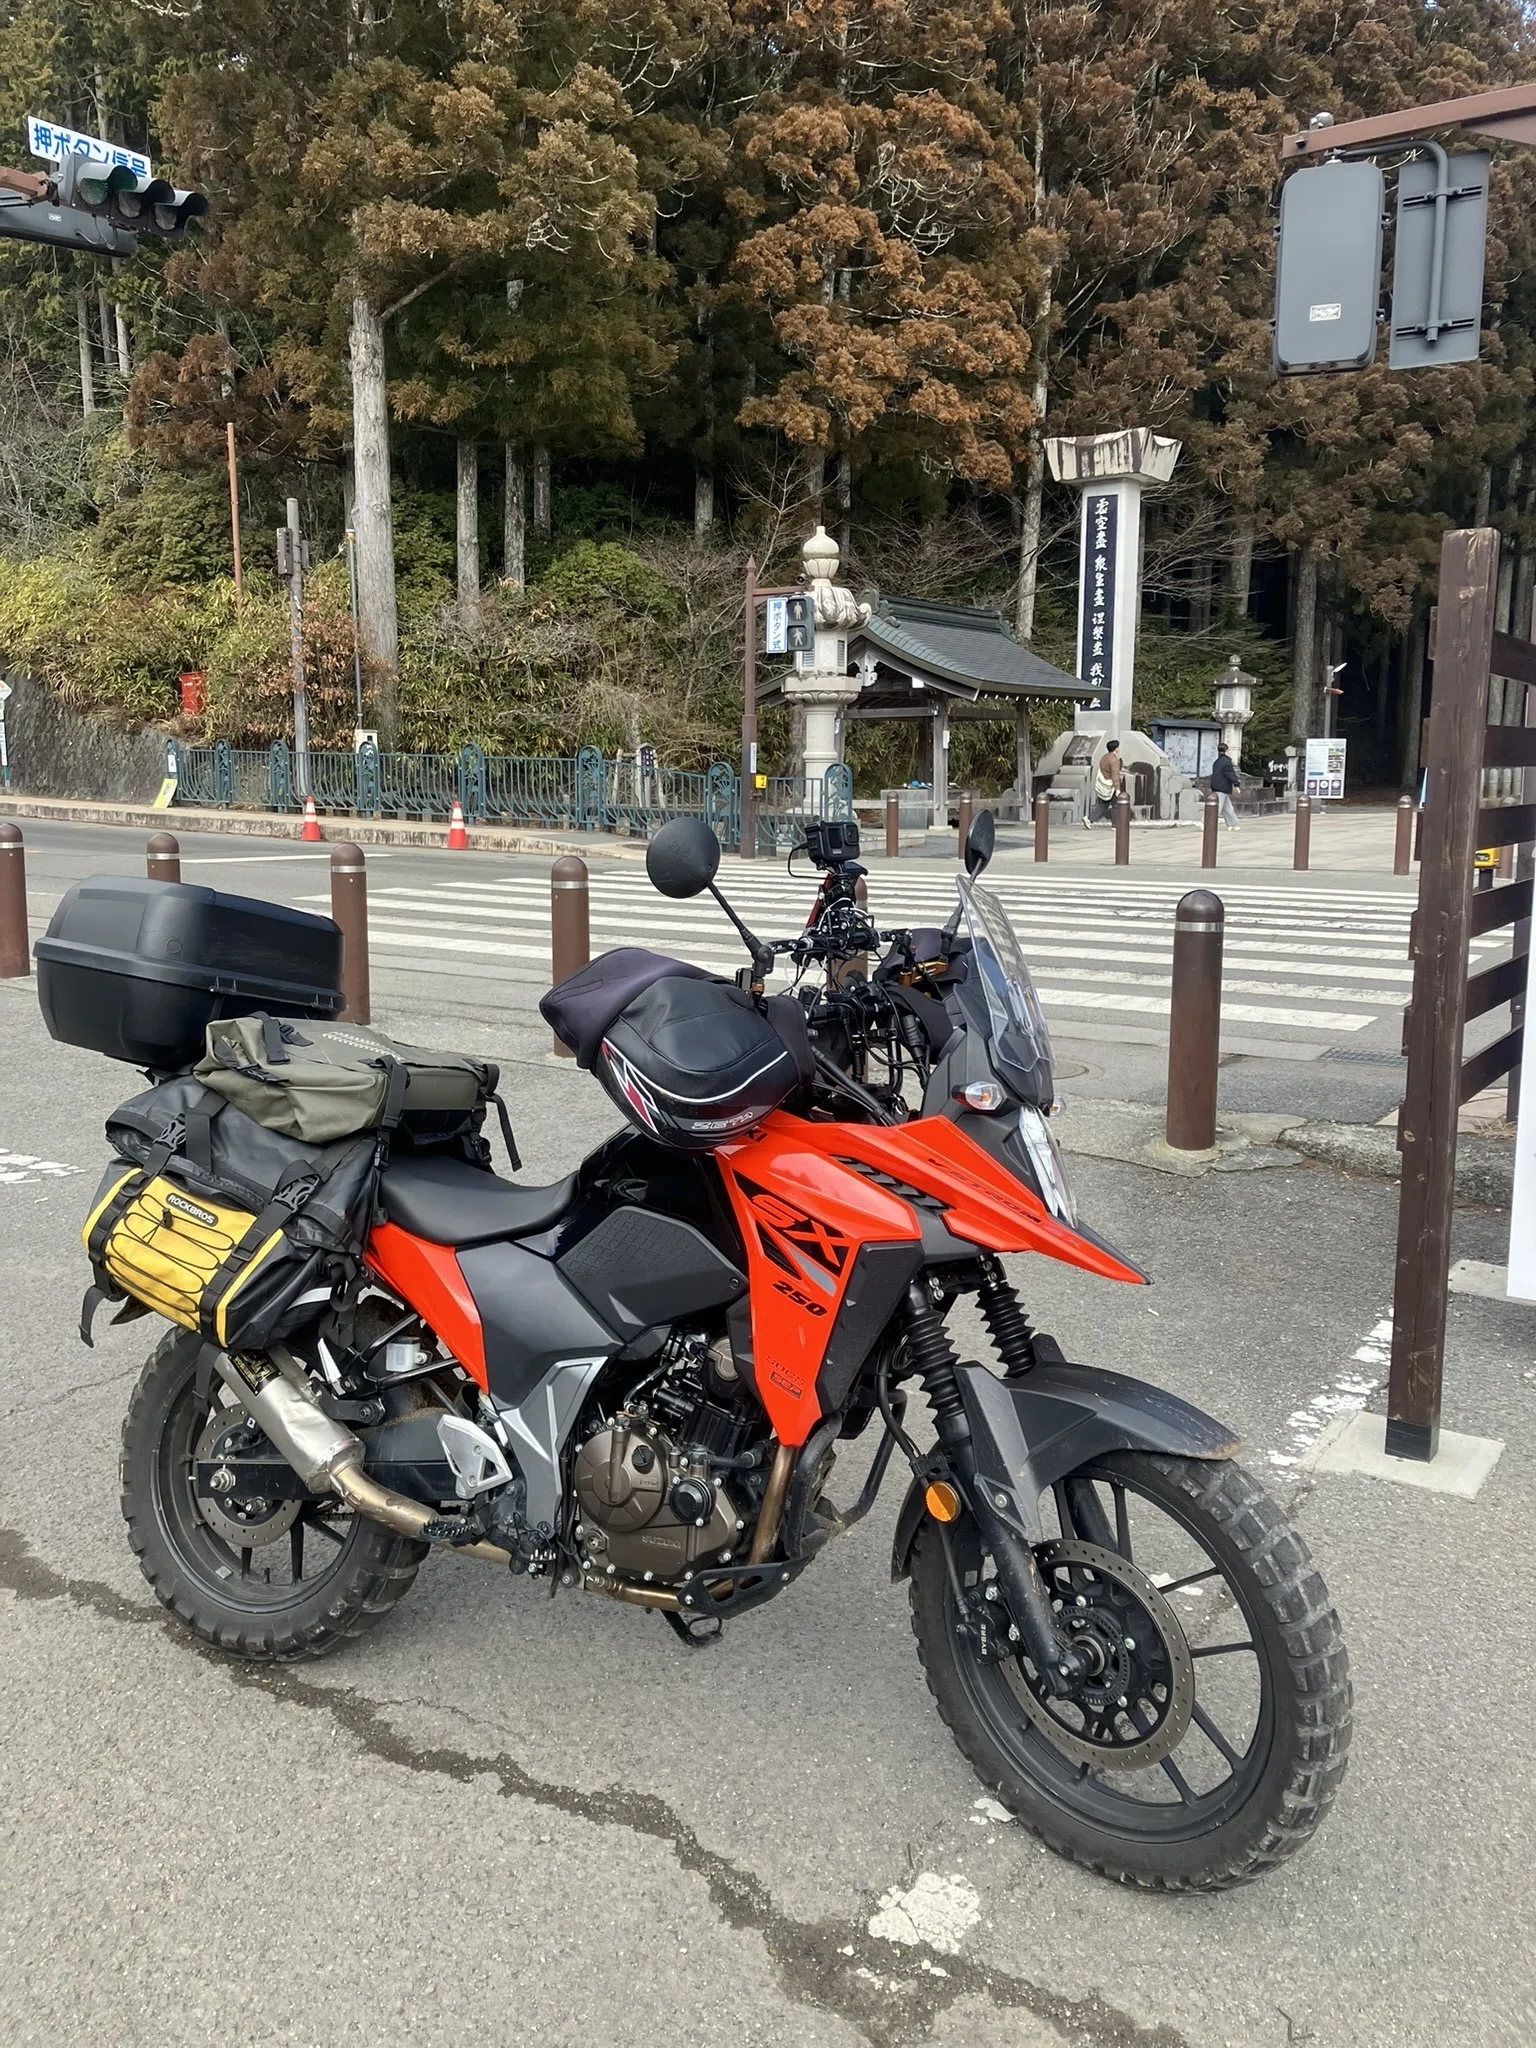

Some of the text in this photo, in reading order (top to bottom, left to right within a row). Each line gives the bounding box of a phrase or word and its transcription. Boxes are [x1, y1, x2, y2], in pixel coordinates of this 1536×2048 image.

[167, 1194, 215, 1225] ROCKBROS
[771, 1279, 829, 1318] 250
[641, 1534, 682, 1550] SUZUKI
